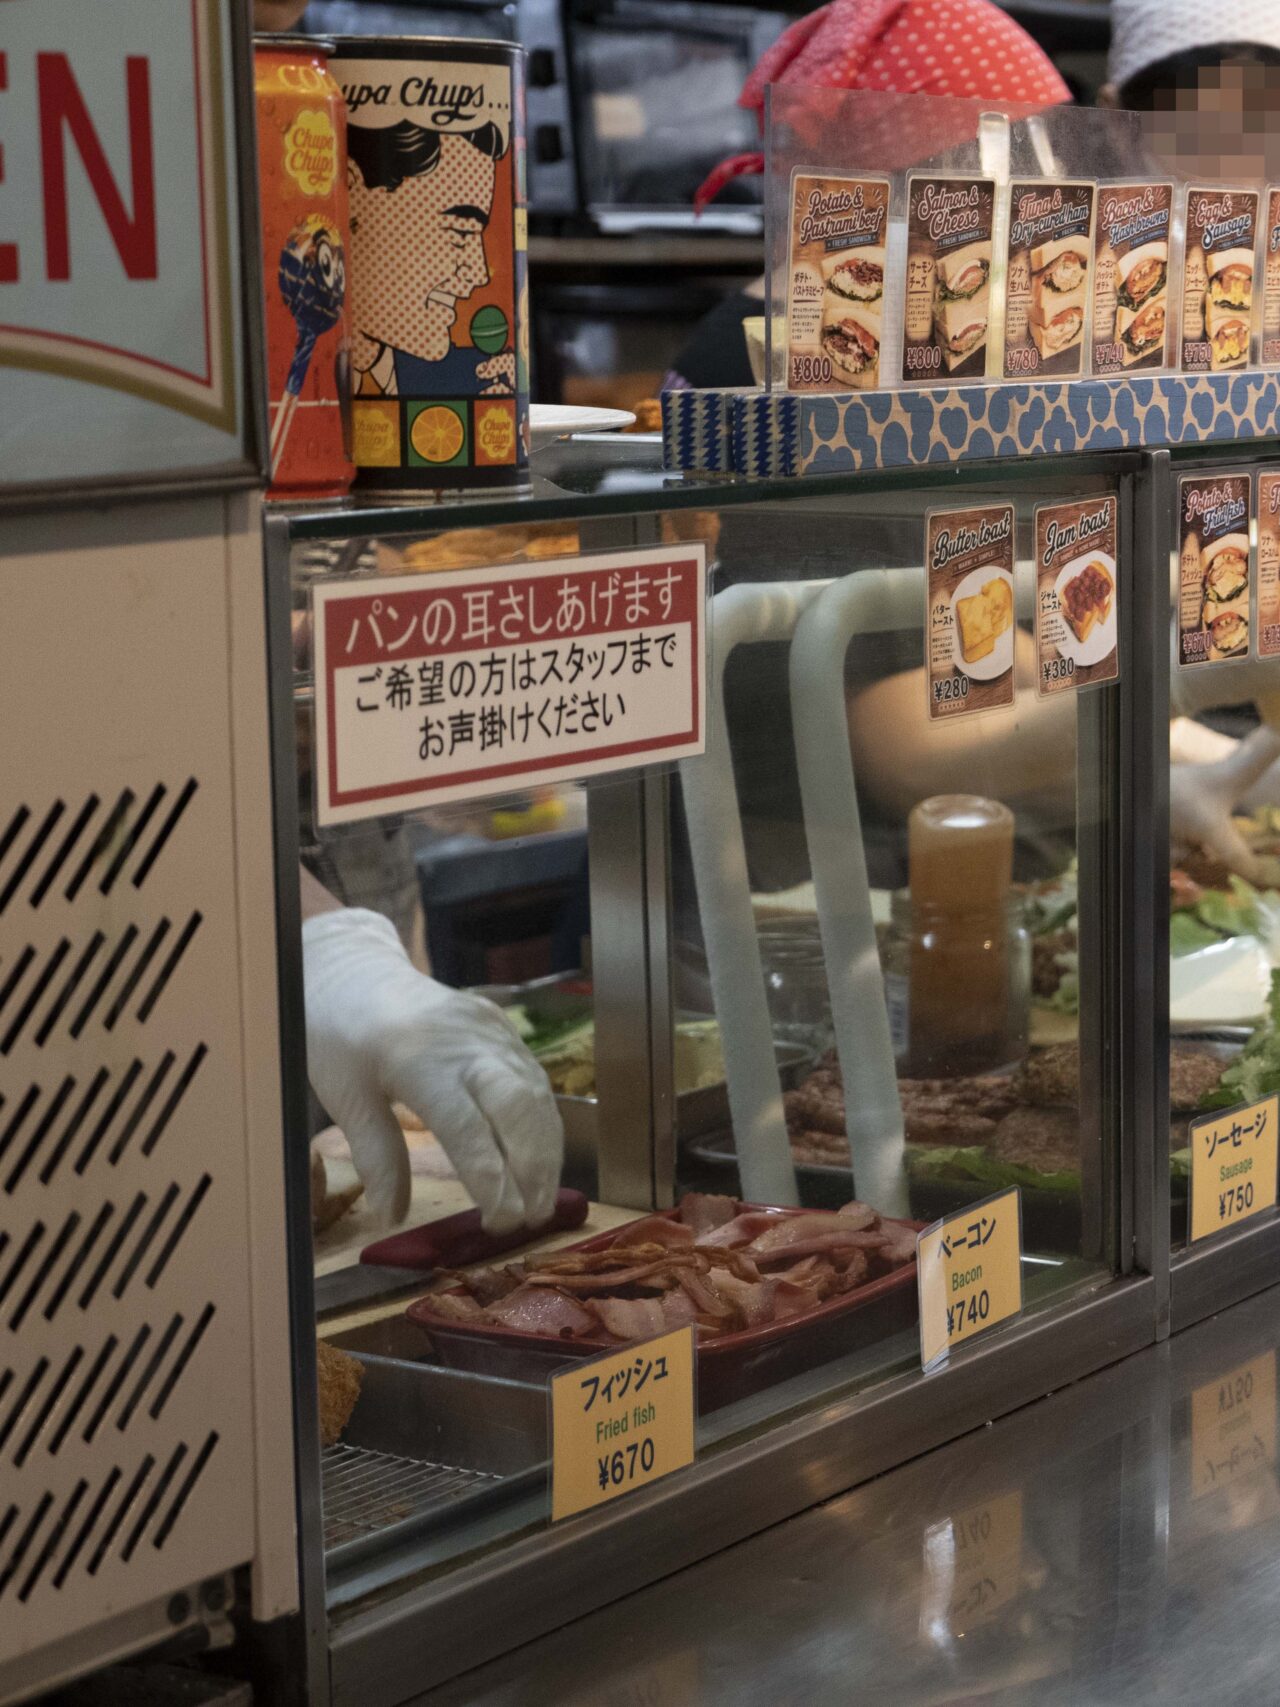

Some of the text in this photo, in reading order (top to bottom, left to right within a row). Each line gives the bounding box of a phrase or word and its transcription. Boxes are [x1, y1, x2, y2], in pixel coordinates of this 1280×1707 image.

[0, 51, 158, 283] N
[808, 185, 864, 217] Potato &
[918, 184, 979, 221] Salmon &
[1018, 188, 1062, 222] Tuna &
[1102, 187, 1155, 230] Bacon &
[1195, 194, 1233, 227] Egg &
[800, 206, 885, 244] Pastrami beef
[930, 209, 979, 240] Cheese
[1011, 202, 1089, 245] Dry-cured ham
[1202, 213, 1252, 249] Sausage
[909, 275, 928, 289] チーズ
[1009, 281, 1030, 293] 生ハム
[793, 355, 832, 382] ¥800
[907, 346, 942, 370] ¥800
[1008, 347, 1039, 370] ¥780
[1096, 343, 1124, 364] ¥740
[1185, 481, 1233, 522] Potato &
[932, 510, 1011, 570] Butter toast
[1042, 519, 1077, 567] Jam
[1077, 500, 1110, 541] toast
[345, 566, 684, 654] パンの耳さしあげます
[932, 604, 951, 616] バター
[1041, 589, 1058, 601] ジャム
[1041, 599, 1063, 613] トースト
[932, 615, 954, 628] トースト
[1183, 630, 1213, 655] ¥670
[356, 632, 677, 712] ご希望の方はスタッフまで
[1043, 656, 1076, 682] ¥380
[934, 676, 969, 702] ¥280
[418, 691, 627, 760] お声掛けください
[1205, 1109, 1267, 1159] ソーセージ
[1219, 1158, 1253, 1182] Sausage
[1219, 1181, 1254, 1220] ¥750
[937, 1217, 997, 1259] ベーコン
[951, 1265, 983, 1292] Bacon
[946, 1289, 990, 1336] ¥740
[580, 1356, 668, 1412] フィッシュ
[595, 1401, 656, 1444] Fried fish
[598, 1438, 655, 1491] ¥670
